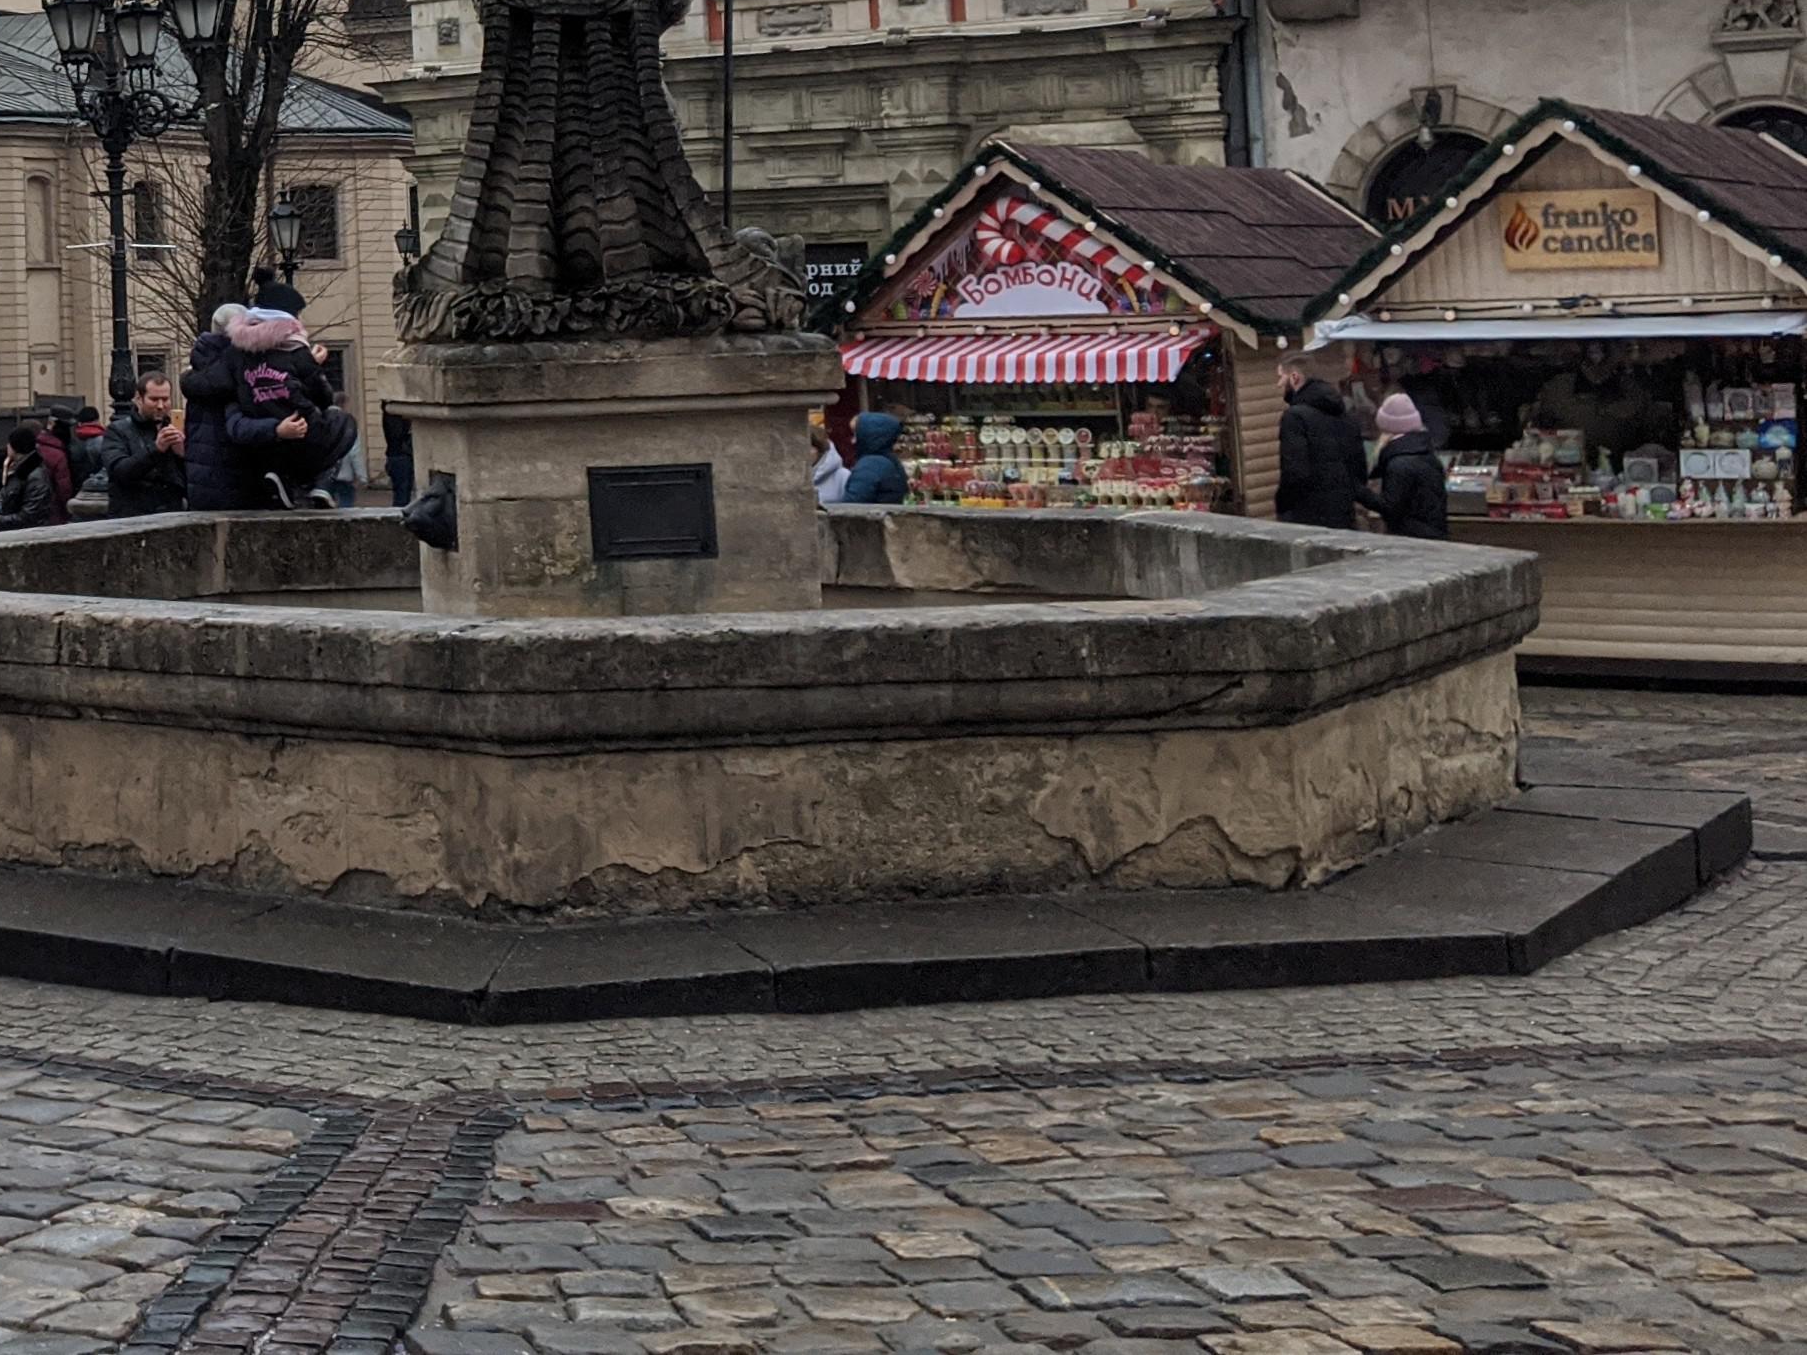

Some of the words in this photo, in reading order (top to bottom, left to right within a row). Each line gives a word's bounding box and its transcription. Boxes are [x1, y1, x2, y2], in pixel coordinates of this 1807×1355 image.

[1541, 201, 1638, 229] franko
[1542, 218, 1656, 254] candles
[805, 257, 864, 281] рний
